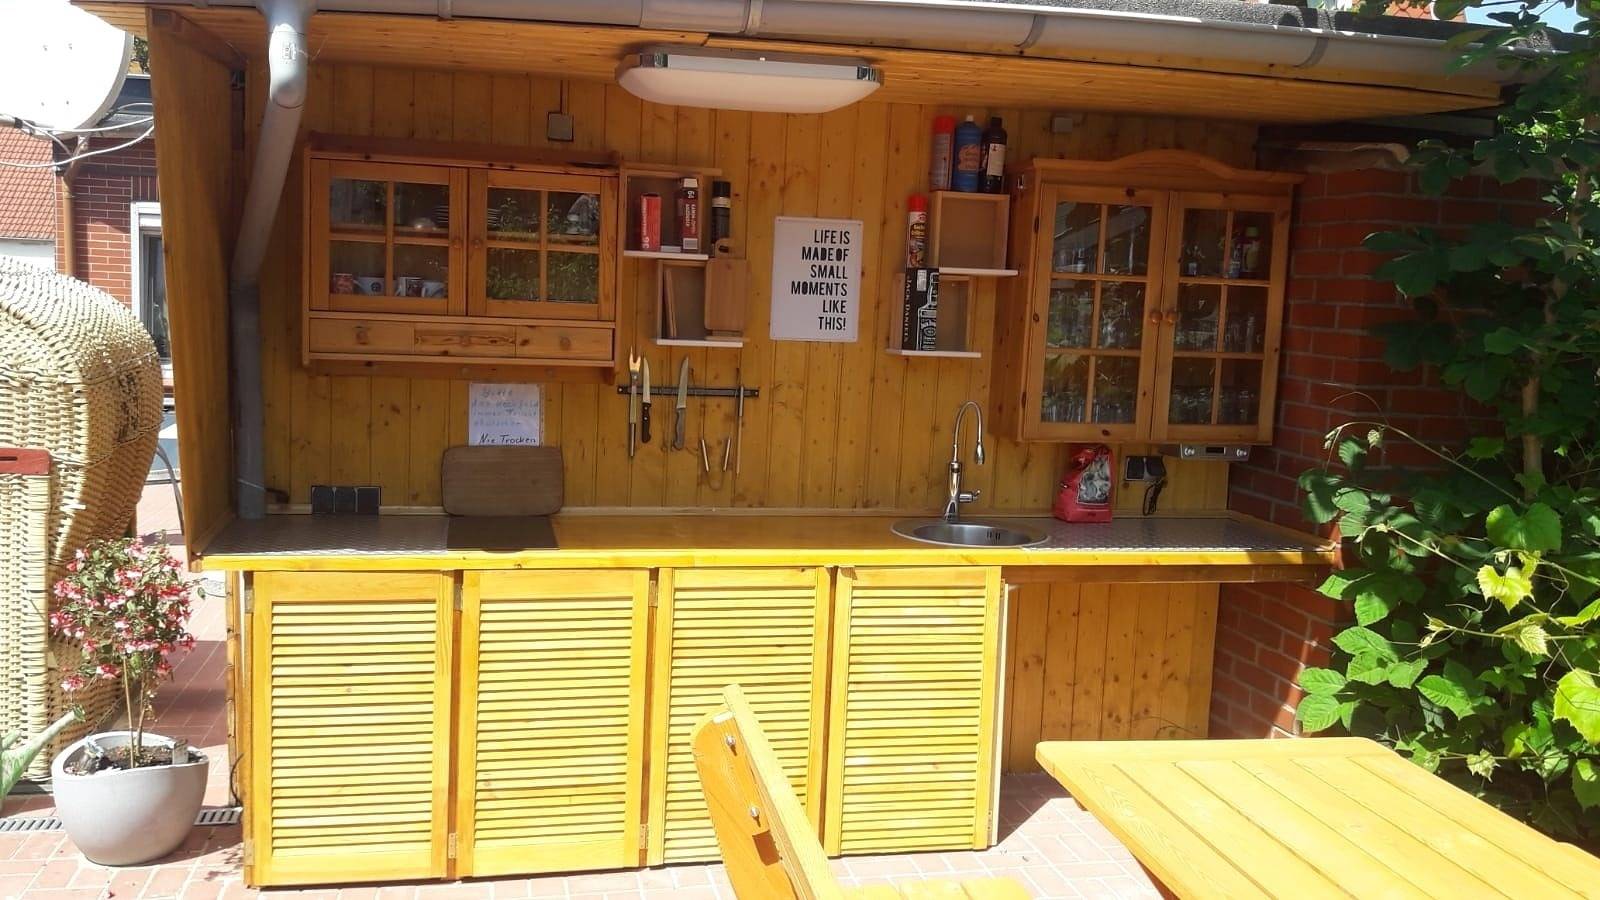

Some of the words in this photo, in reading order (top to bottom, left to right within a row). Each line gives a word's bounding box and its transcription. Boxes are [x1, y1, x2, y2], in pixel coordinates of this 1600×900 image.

[687, 190, 695, 199] 64
[814, 229, 837, 244] LIFE
[839, 230, 850, 245] IS
[801, 246, 834, 261] MADE
[835, 248, 850, 262] OF
[810, 264, 848, 279] SMALL
[791, 281, 847, 297] MOMENTS
[822, 299, 847, 314] LIKE
[818, 316, 846, 331] THIS!
[480, 433, 497, 444] Nie
[500, 434, 536, 444] Trocken
